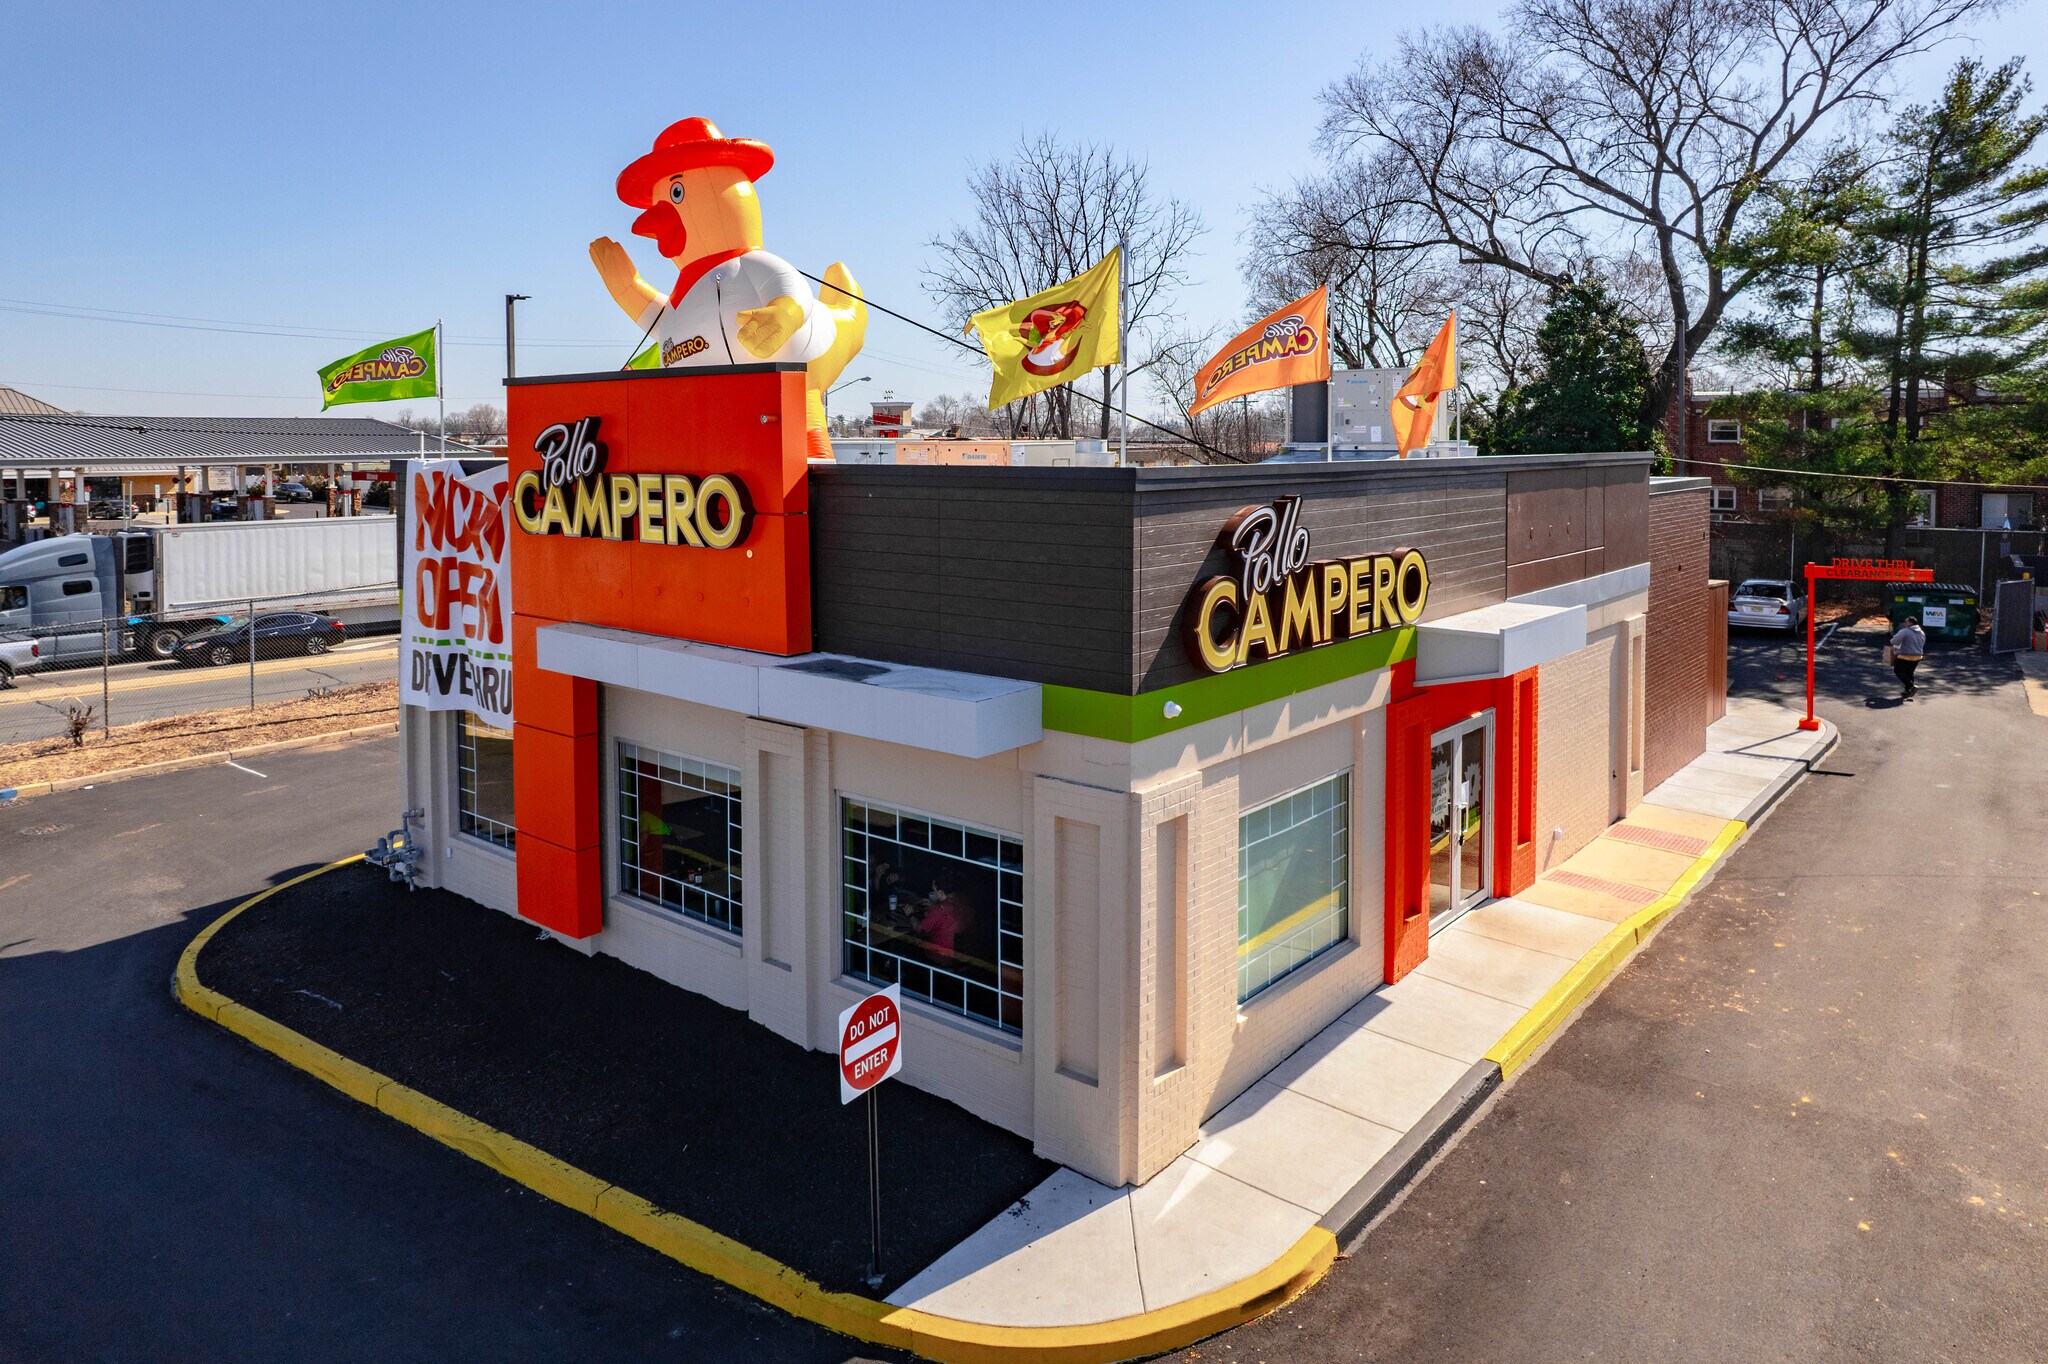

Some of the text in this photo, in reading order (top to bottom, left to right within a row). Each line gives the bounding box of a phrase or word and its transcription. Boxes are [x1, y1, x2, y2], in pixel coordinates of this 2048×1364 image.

[663, 337, 704, 366] CAMPERO
[534, 417, 597, 491] Pollo
[414, 471, 510, 564] NOW
[512, 470, 745, 549] CAMPERO
[1232, 495, 1309, 601] Pollo
[1826, 569, 1891, 579] CLEARANCE
[1832, 557, 1914, 570] DRIVE THRU
[416, 556, 504, 645] OPEN
[1194, 549, 1431, 673] CAMPERO
[850, 1006, 889, 1041] DO NOT
[854, 1048, 888, 1079] ENTER
